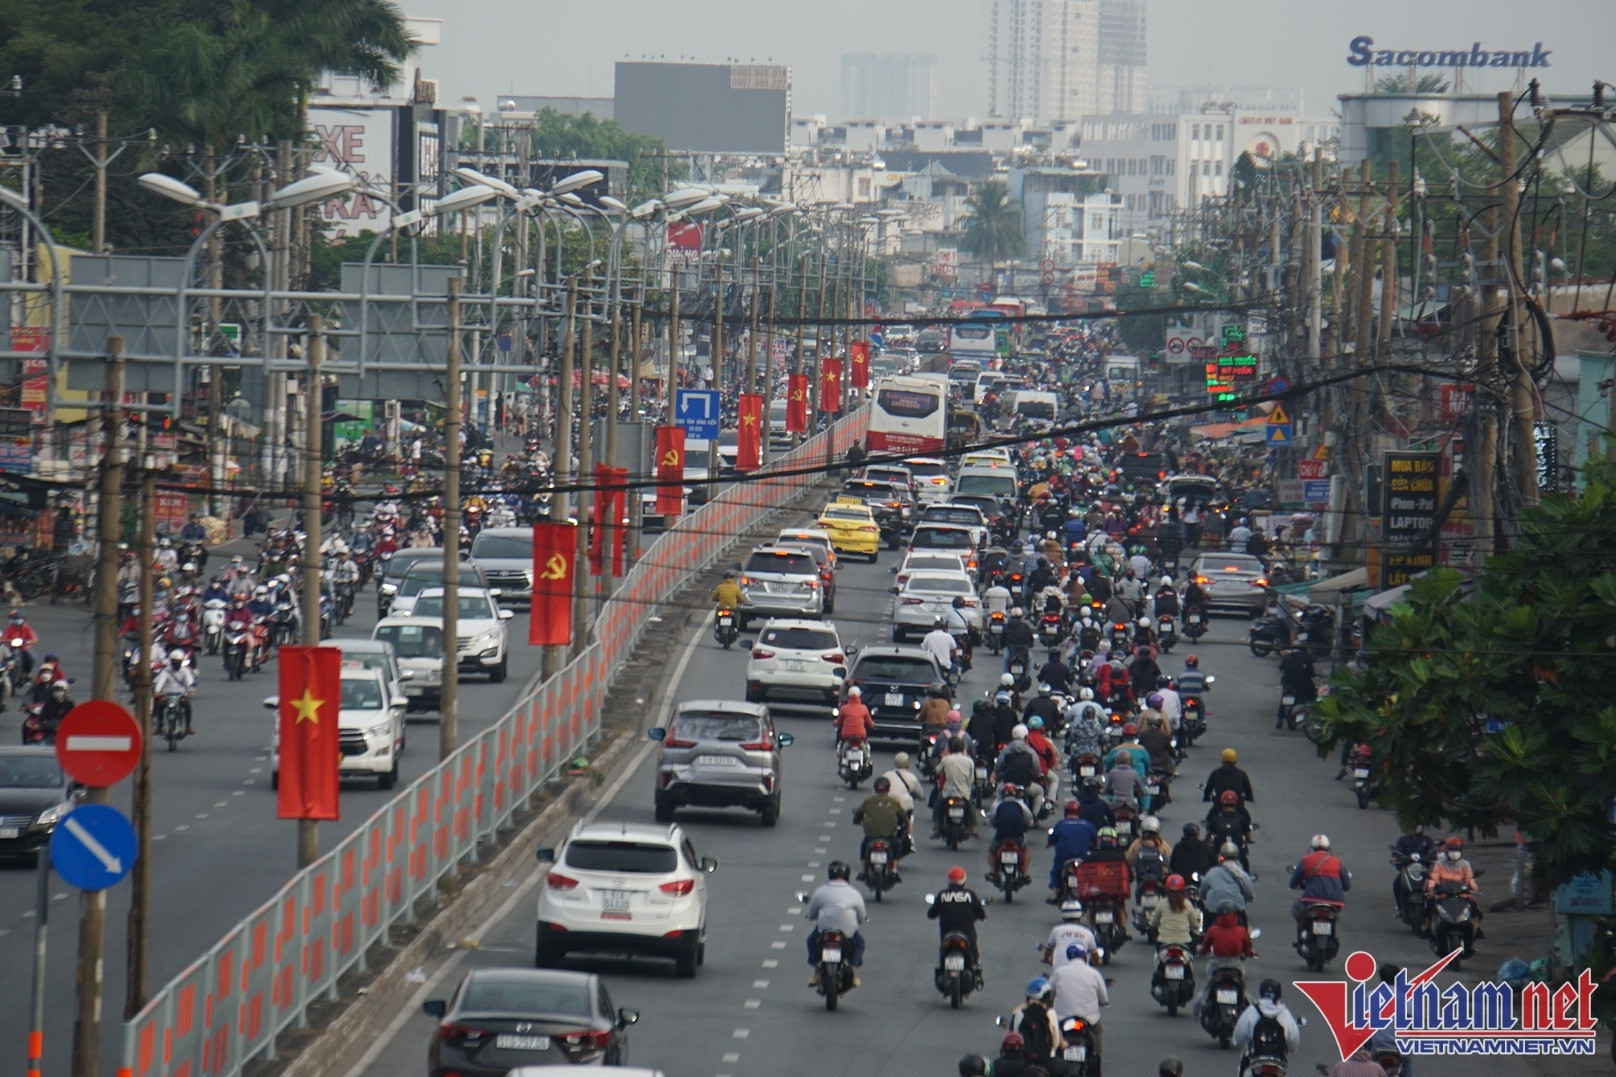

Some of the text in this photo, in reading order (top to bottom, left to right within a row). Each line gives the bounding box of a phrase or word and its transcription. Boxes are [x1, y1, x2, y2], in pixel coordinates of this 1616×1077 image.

[1347, 35, 1552, 67] Sacombank
[1391, 458, 1434, 473] MUA BÁN
[1391, 475, 1434, 492] SỬA CHỮA
[1390, 516, 1433, 529] LAPTOP
[940, 890, 972, 903] NASA
